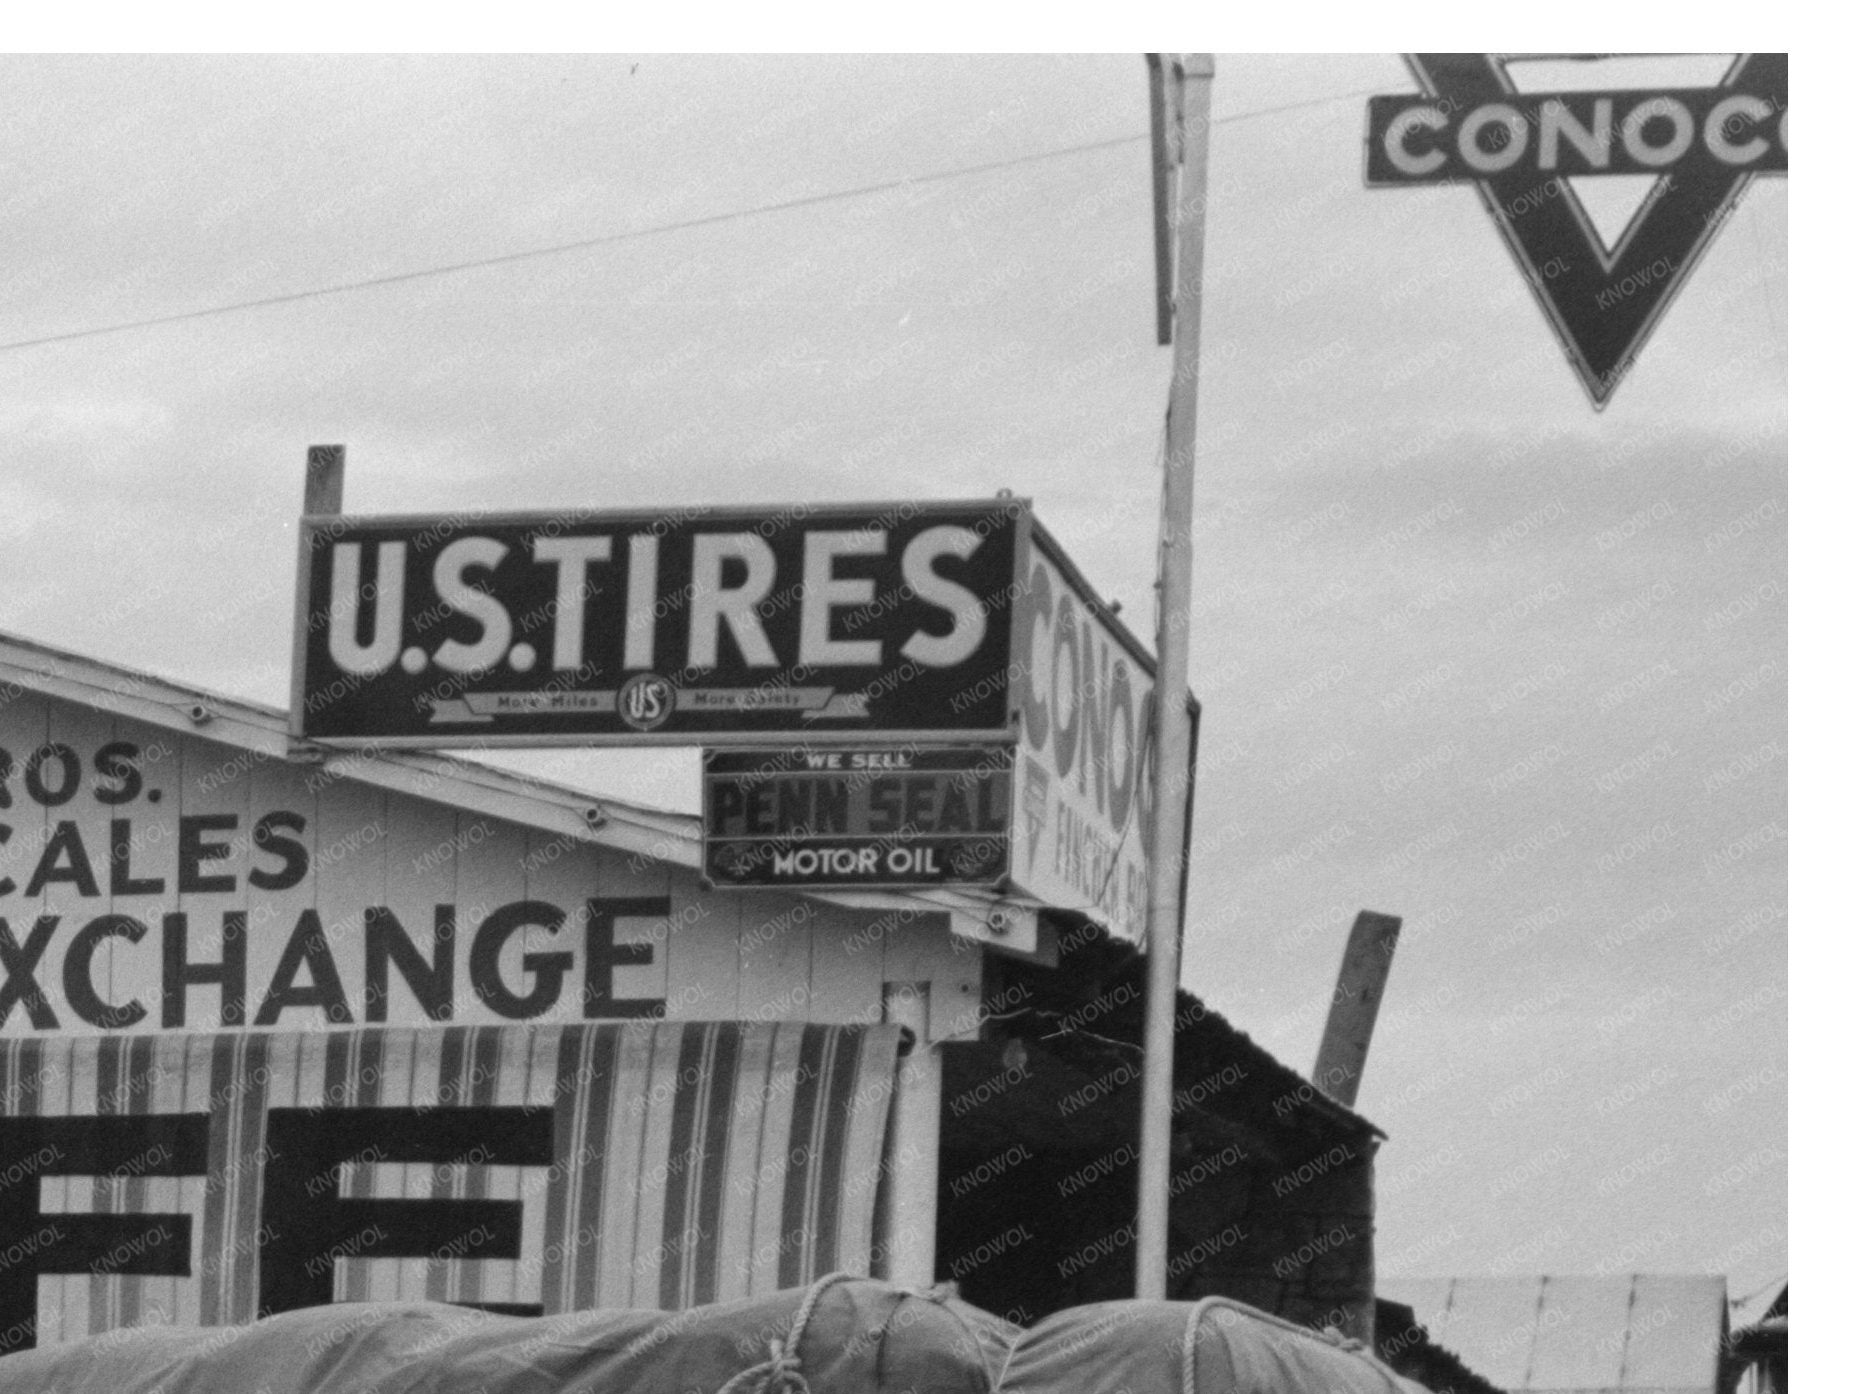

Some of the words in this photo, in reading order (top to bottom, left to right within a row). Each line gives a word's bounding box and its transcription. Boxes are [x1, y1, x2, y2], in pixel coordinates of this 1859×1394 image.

[1384, 95, 1787, 175] CONOC
[631, 683, 661, 719] US
[806, 753, 842, 769] WE
[851, 752, 912, 769] SELL
[774, 848, 878, 875] MOTOR
[887, 847, 941, 874] OIL
